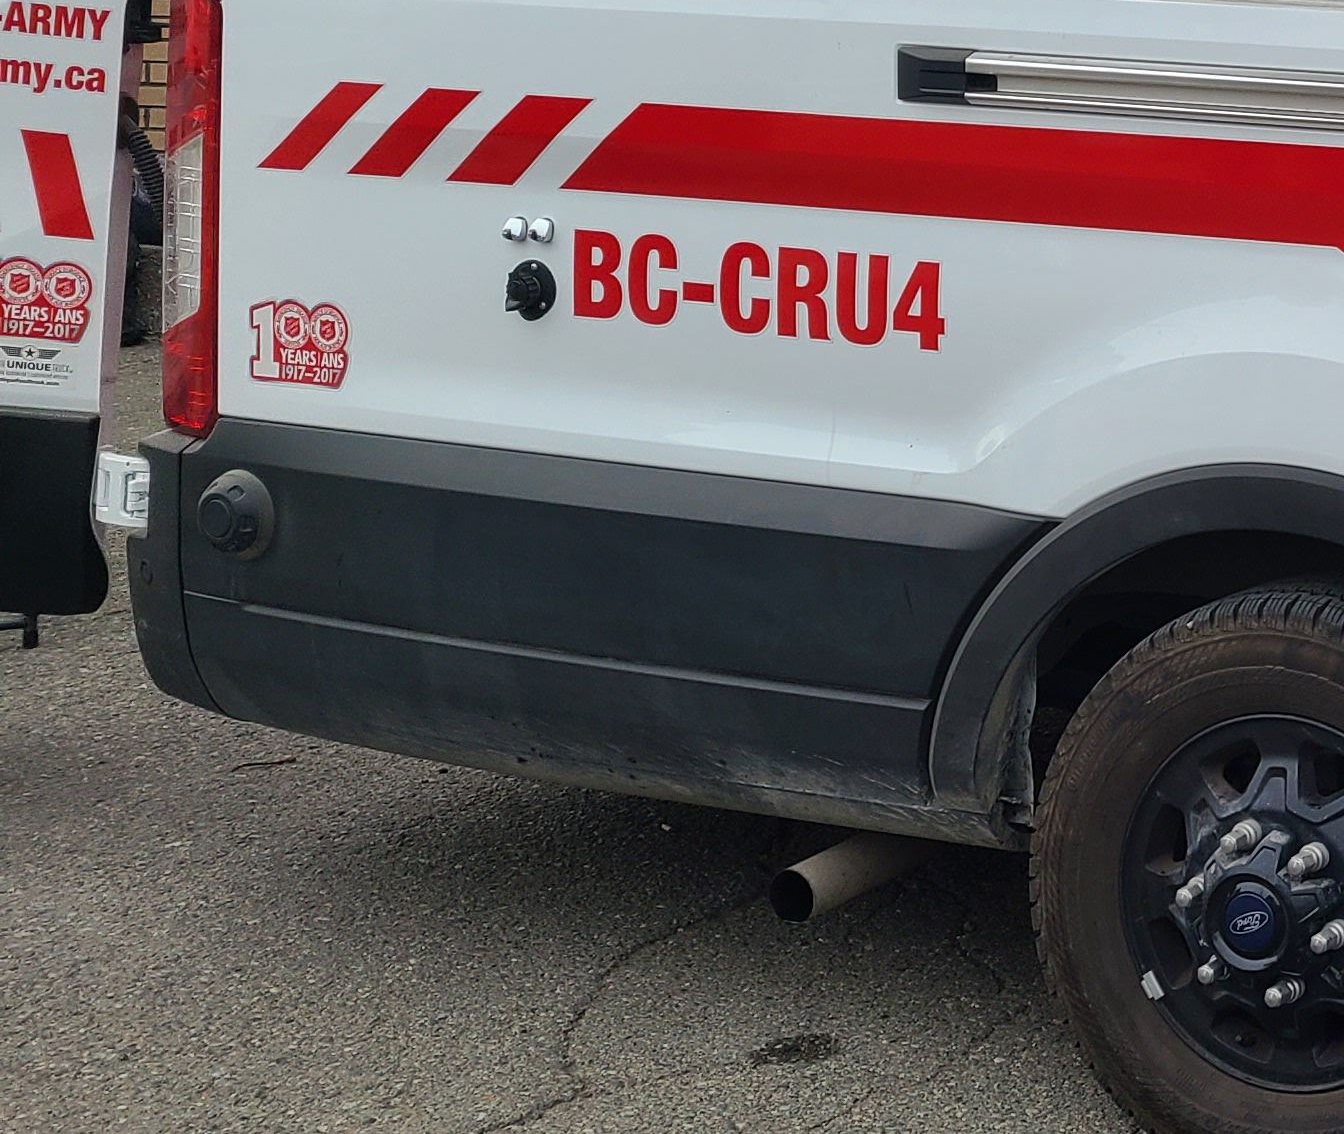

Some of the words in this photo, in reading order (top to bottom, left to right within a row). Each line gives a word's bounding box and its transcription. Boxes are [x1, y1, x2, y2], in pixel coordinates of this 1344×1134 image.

[572, 227, 946, 353] BC-CRU4
[3, 304, 49, 322] YEARS
[54, 309, 85, 325] ANS
[6, 360, 52, 372] UNIQUE
[280, 348, 317, 366] YEARS
[321, 353, 344, 369] ANS
